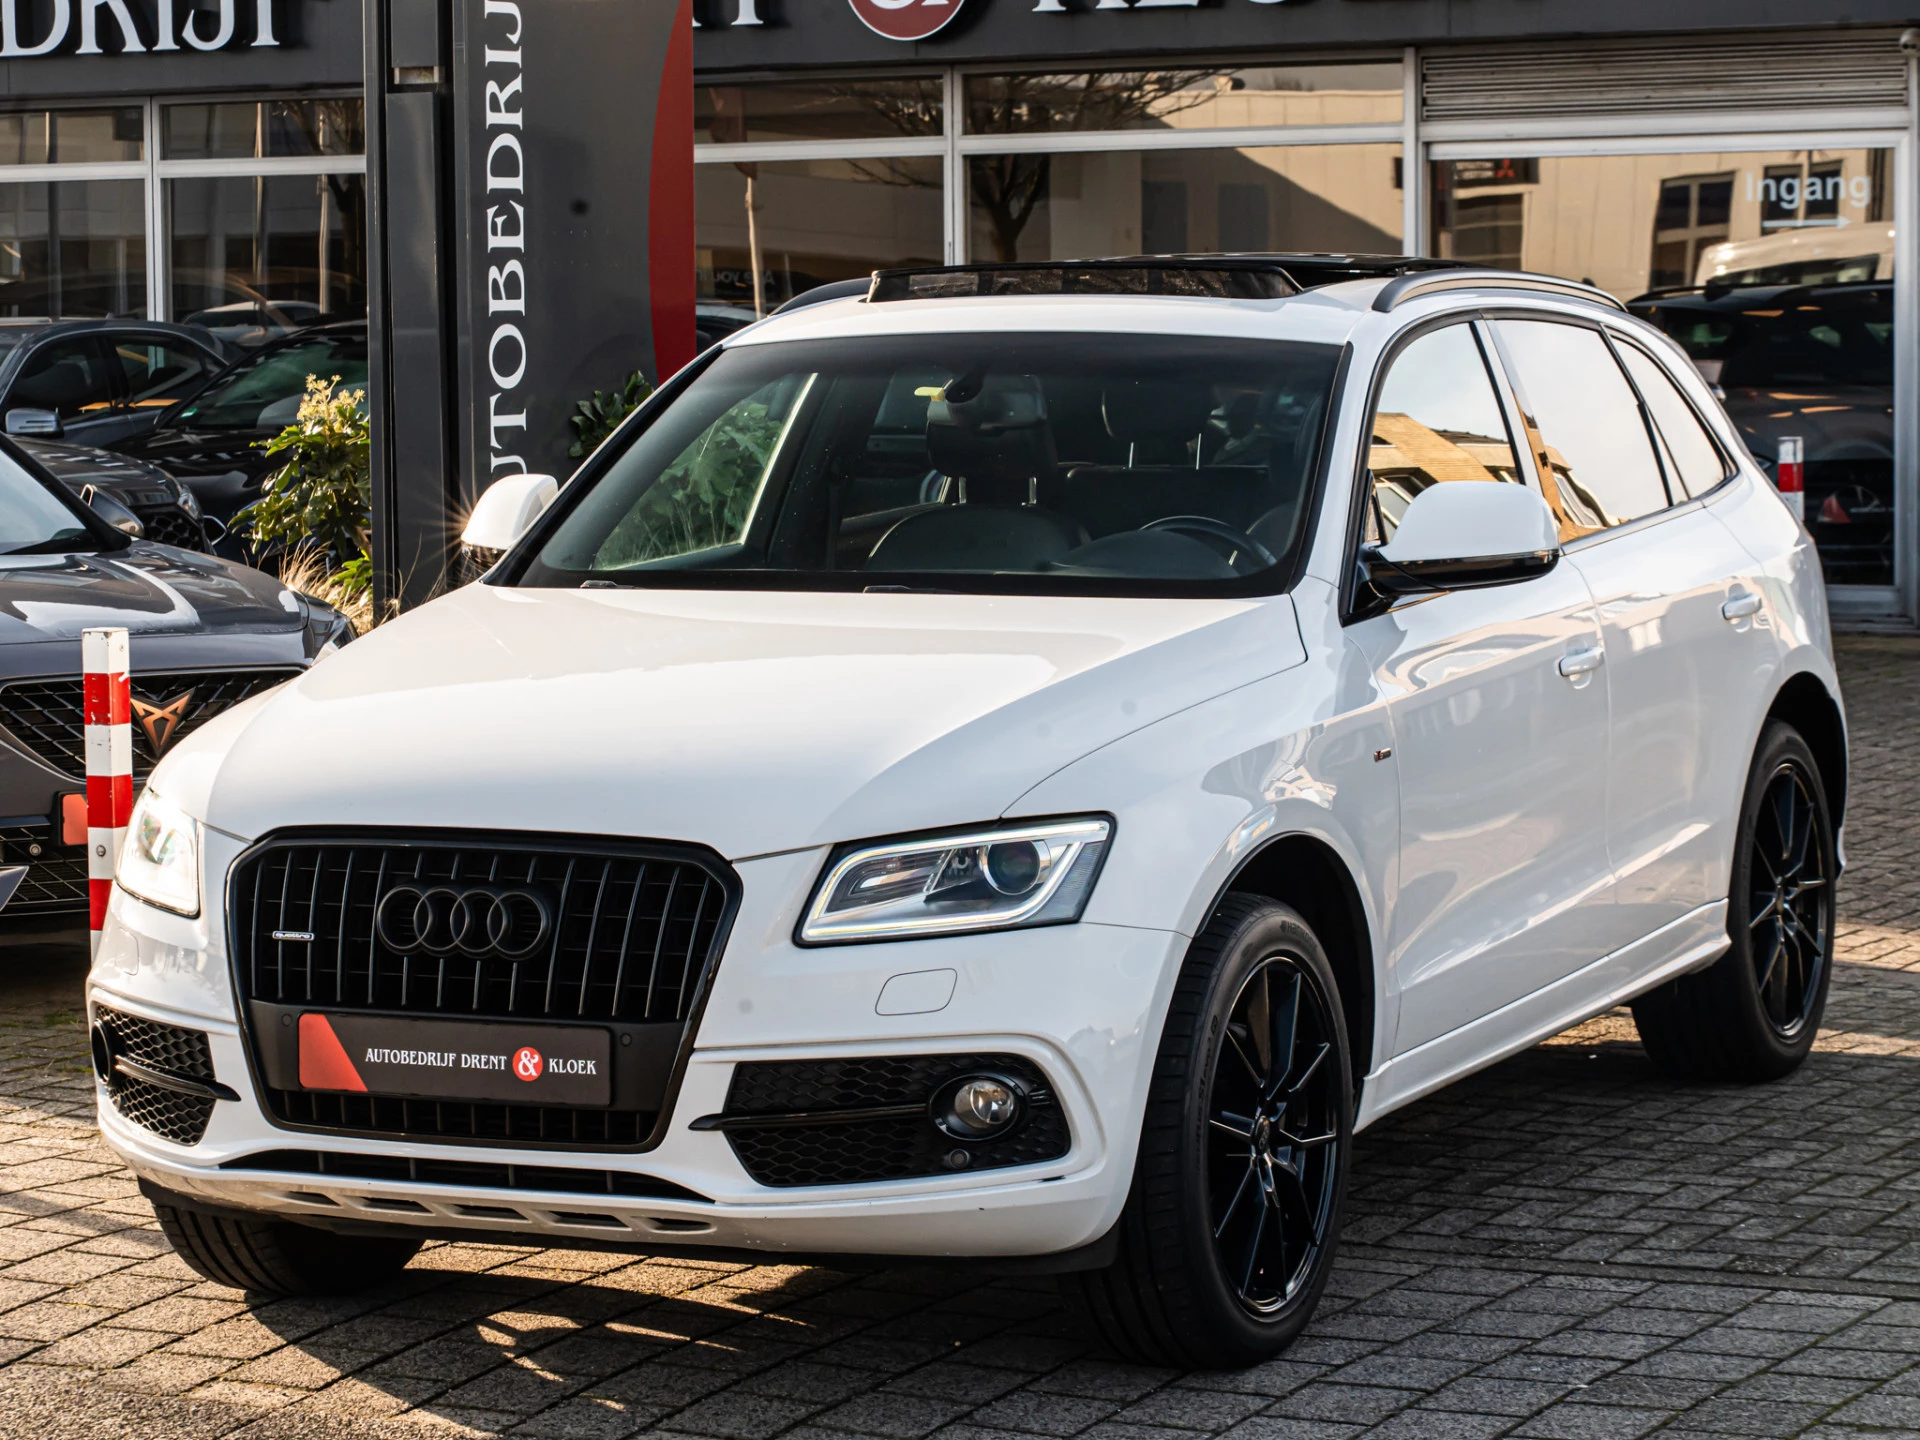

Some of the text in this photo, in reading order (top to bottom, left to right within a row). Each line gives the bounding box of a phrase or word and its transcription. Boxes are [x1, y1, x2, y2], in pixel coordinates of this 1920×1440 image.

[1745, 171, 1871, 210] Ingang
[274, 932, 312, 940] quattro
[365, 1048, 597, 1077] AUTOBEDRIJF DRENT & KLOEK
